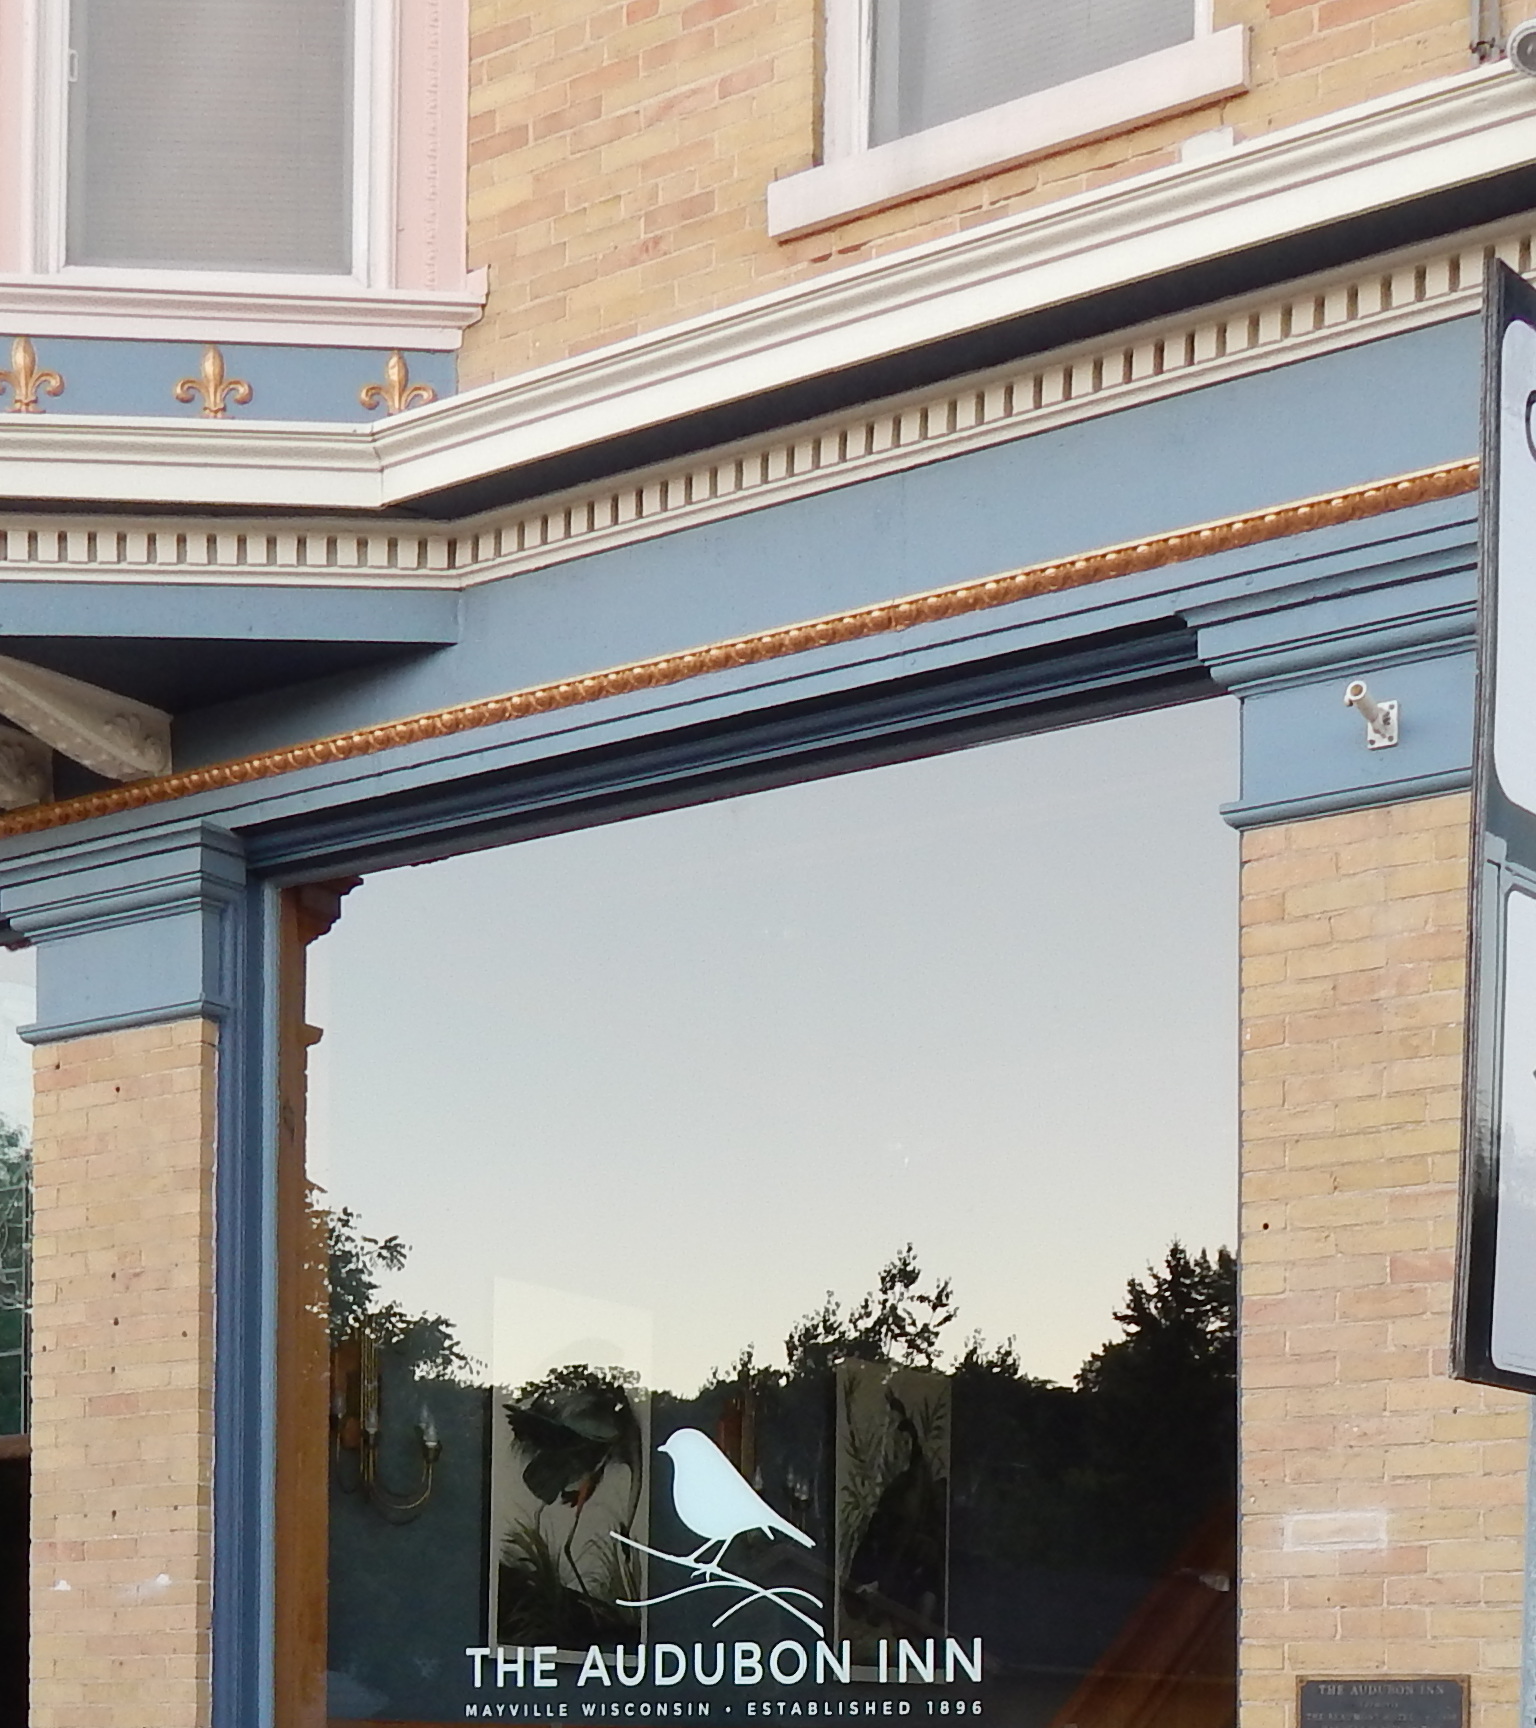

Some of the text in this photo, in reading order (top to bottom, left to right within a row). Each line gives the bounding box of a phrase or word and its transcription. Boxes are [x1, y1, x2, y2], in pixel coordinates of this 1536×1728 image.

[466, 1637, 982, 1688] THE AUDUBON INN
[1318, 1684, 1344, 1696] THE
[1350, 1684, 1414, 1696] AUDUBON
[465, 1701, 982, 1717] MAYVILLE WISCONSIN ESTABLISHED 1896
